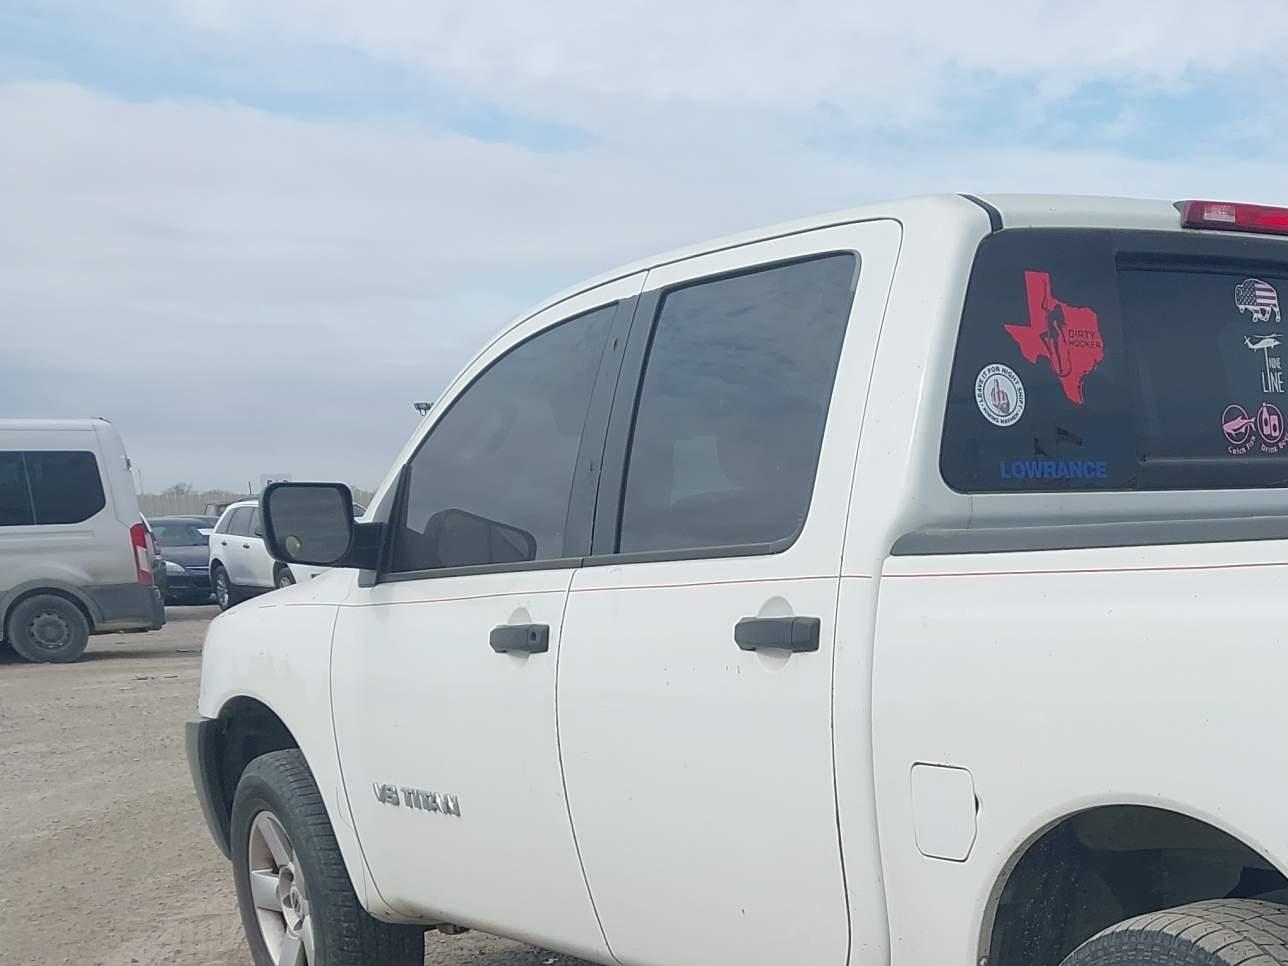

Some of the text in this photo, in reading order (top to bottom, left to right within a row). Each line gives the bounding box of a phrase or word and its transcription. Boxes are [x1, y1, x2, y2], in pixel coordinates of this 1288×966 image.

[1068, 329, 1096, 339] DIRTY
[1001, 367, 1019, 385] NIGHT
[1261, 371, 1285, 393] LINE
[1001, 461, 1107, 479] LOWRANCE
